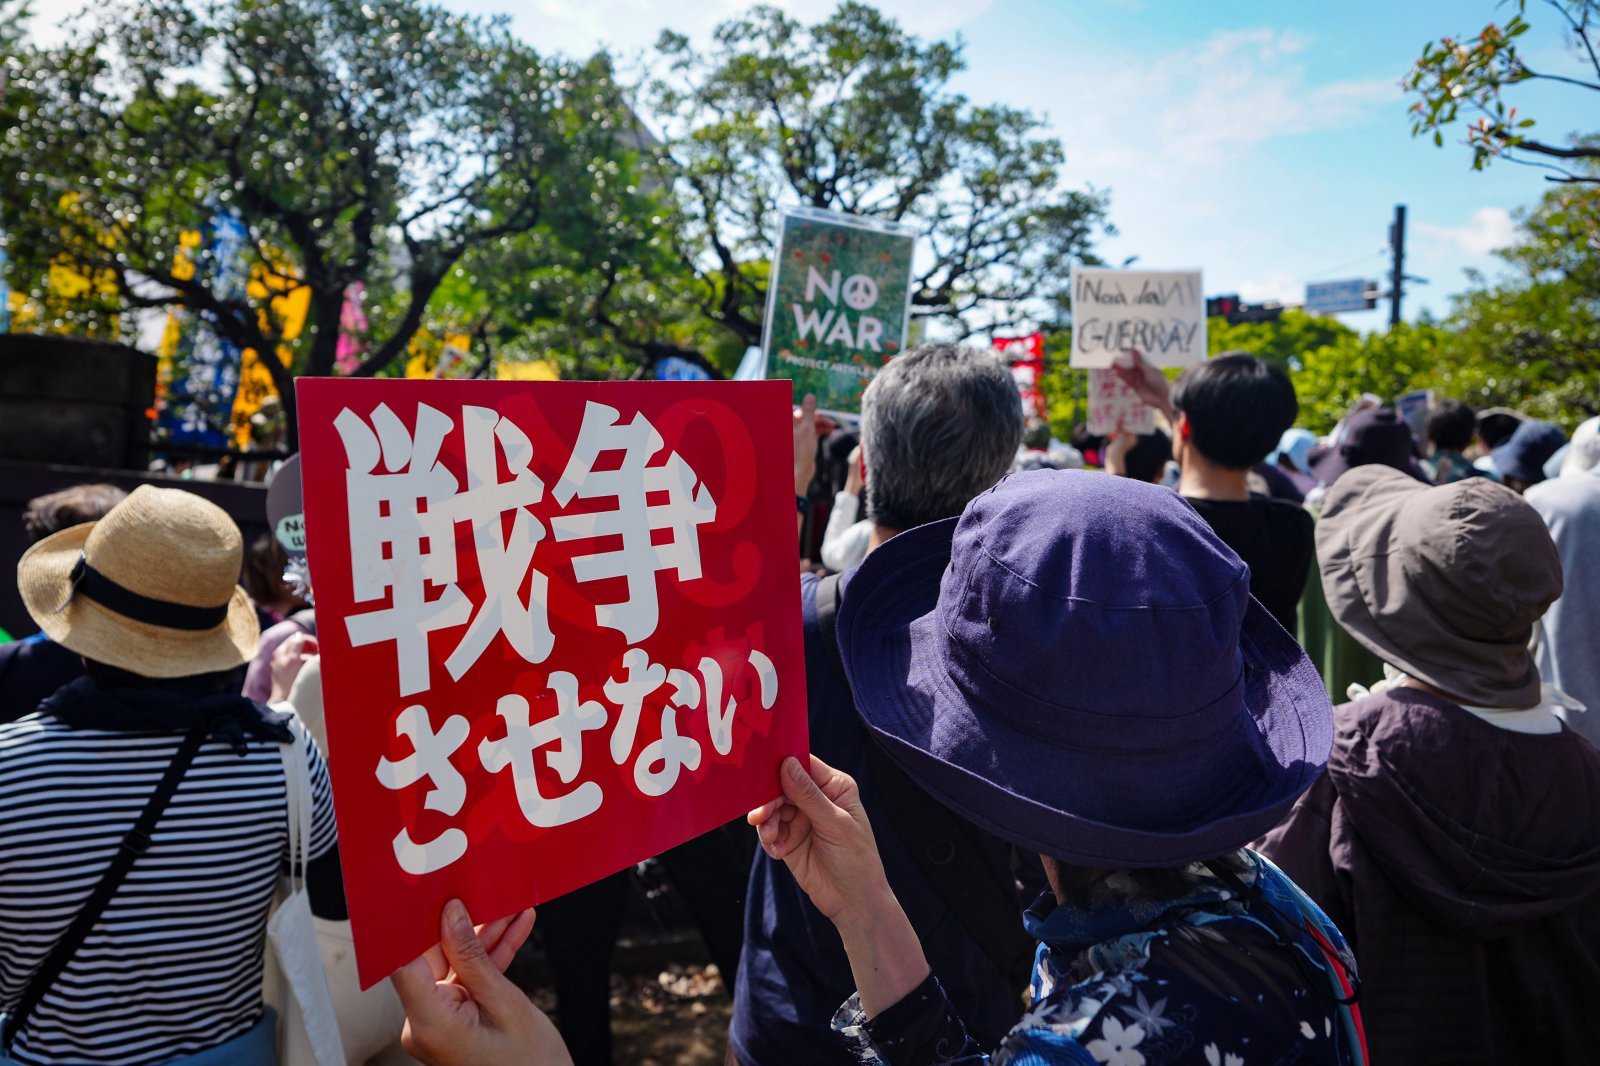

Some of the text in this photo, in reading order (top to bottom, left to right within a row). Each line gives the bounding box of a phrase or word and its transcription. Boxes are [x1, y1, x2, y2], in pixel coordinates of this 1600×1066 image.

[805, 265, 878, 311] NO
[792, 303, 882, 352] WAR
[284, 520, 305, 532] N
[333, 400, 717, 697] 戦争
[375, 647, 778, 875] させない
